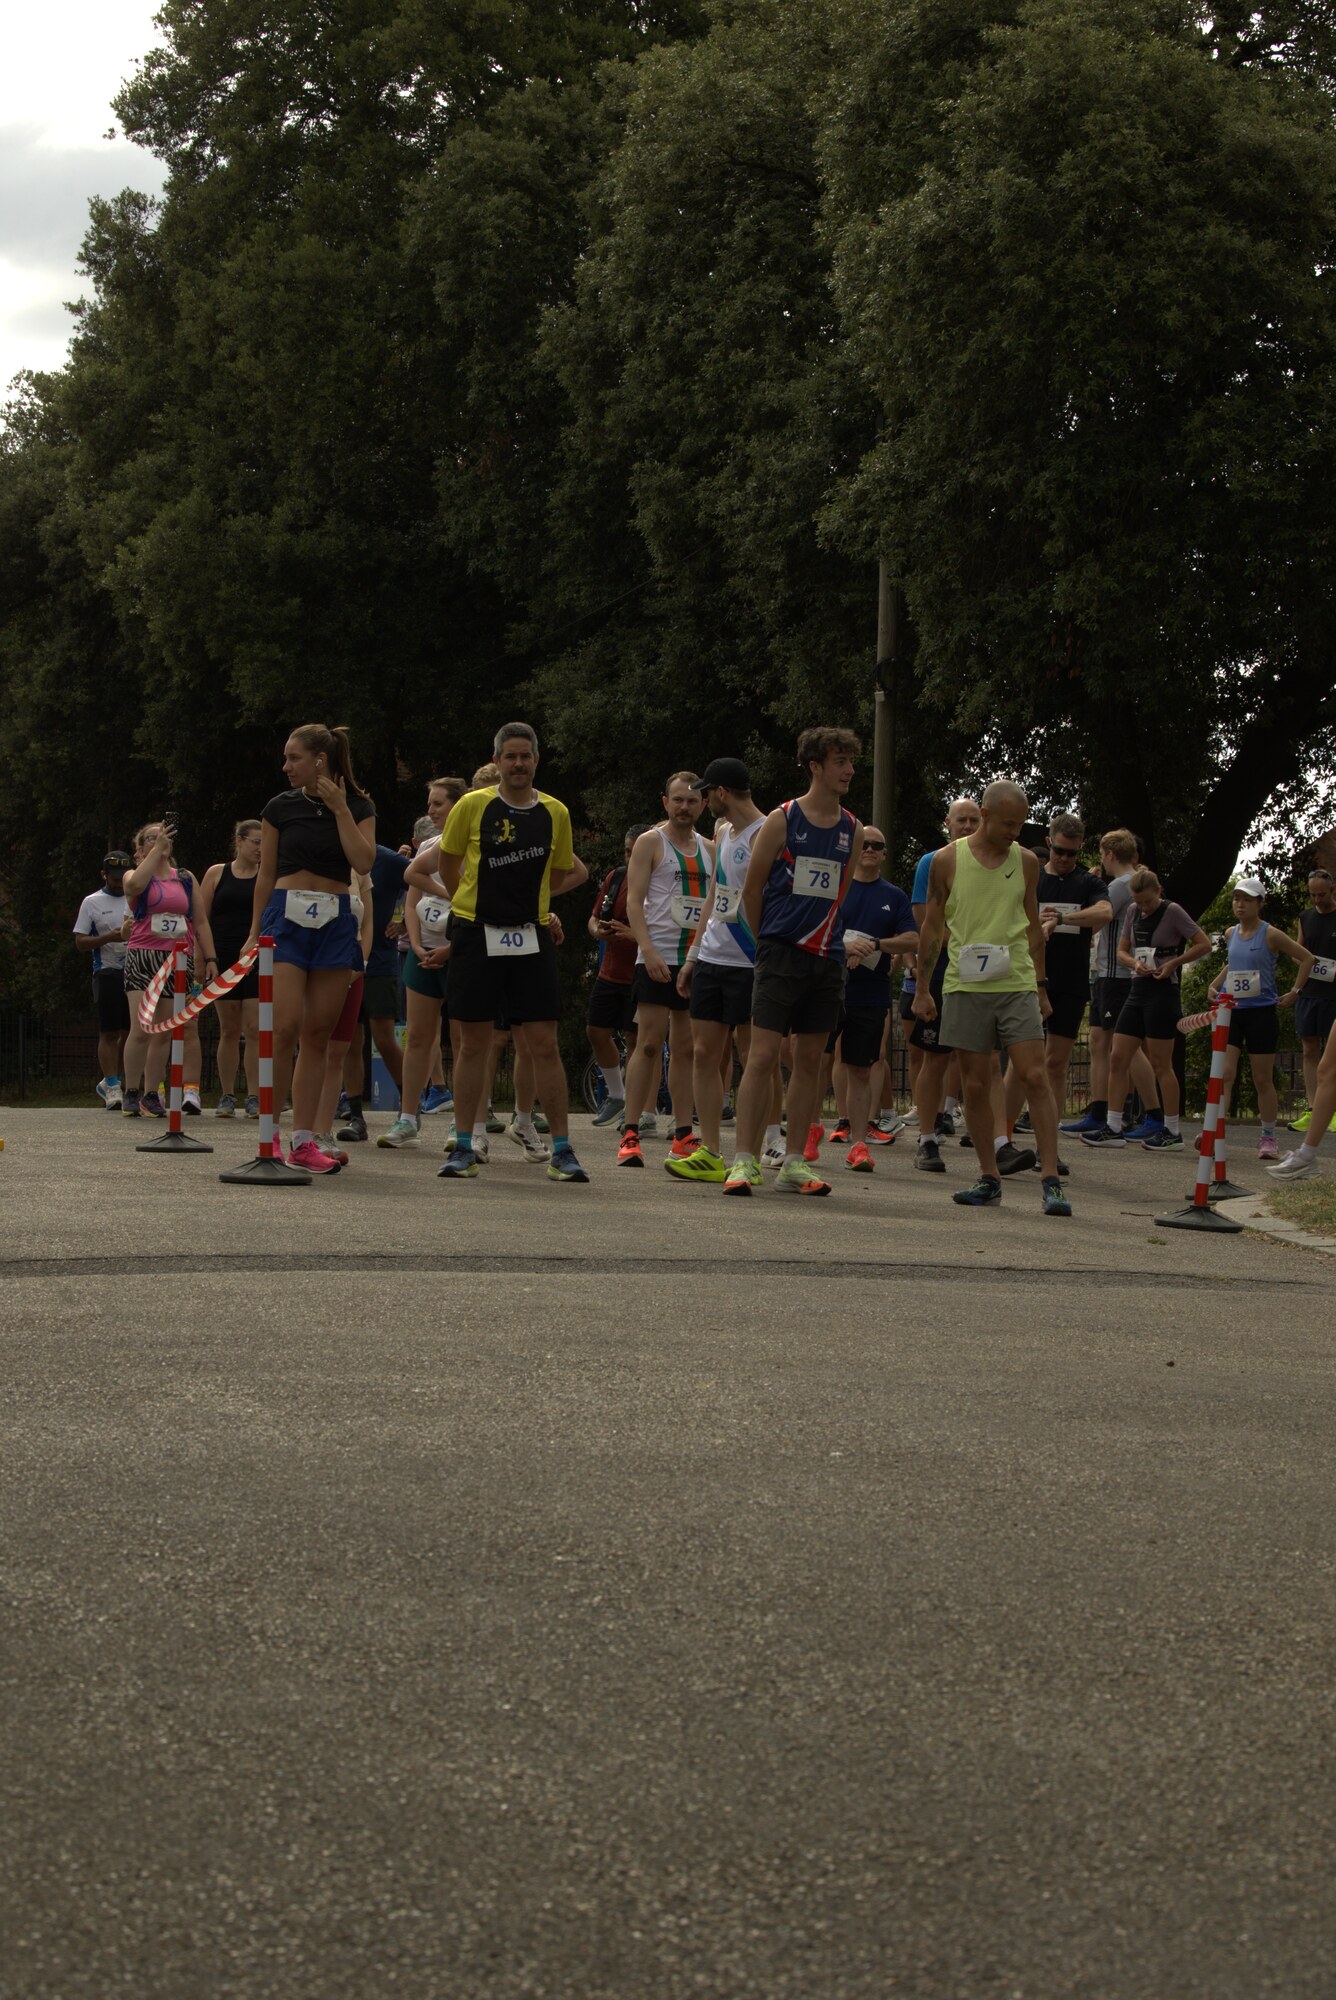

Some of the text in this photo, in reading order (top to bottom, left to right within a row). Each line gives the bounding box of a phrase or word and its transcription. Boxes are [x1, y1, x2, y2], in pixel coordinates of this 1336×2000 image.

[488, 846, 545, 869] Run&Frite
[809, 870, 830, 889] 78
[305, 902, 319, 919] 4
[424, 907, 441, 923] 13
[683, 906, 702, 922] 75
[161, 919, 178, 932] 37
[500, 932, 524, 947] 40
[977, 954, 989, 972] 7
[1313, 964, 1328, 976] 66
[1233, 979, 1250, 992] 38
